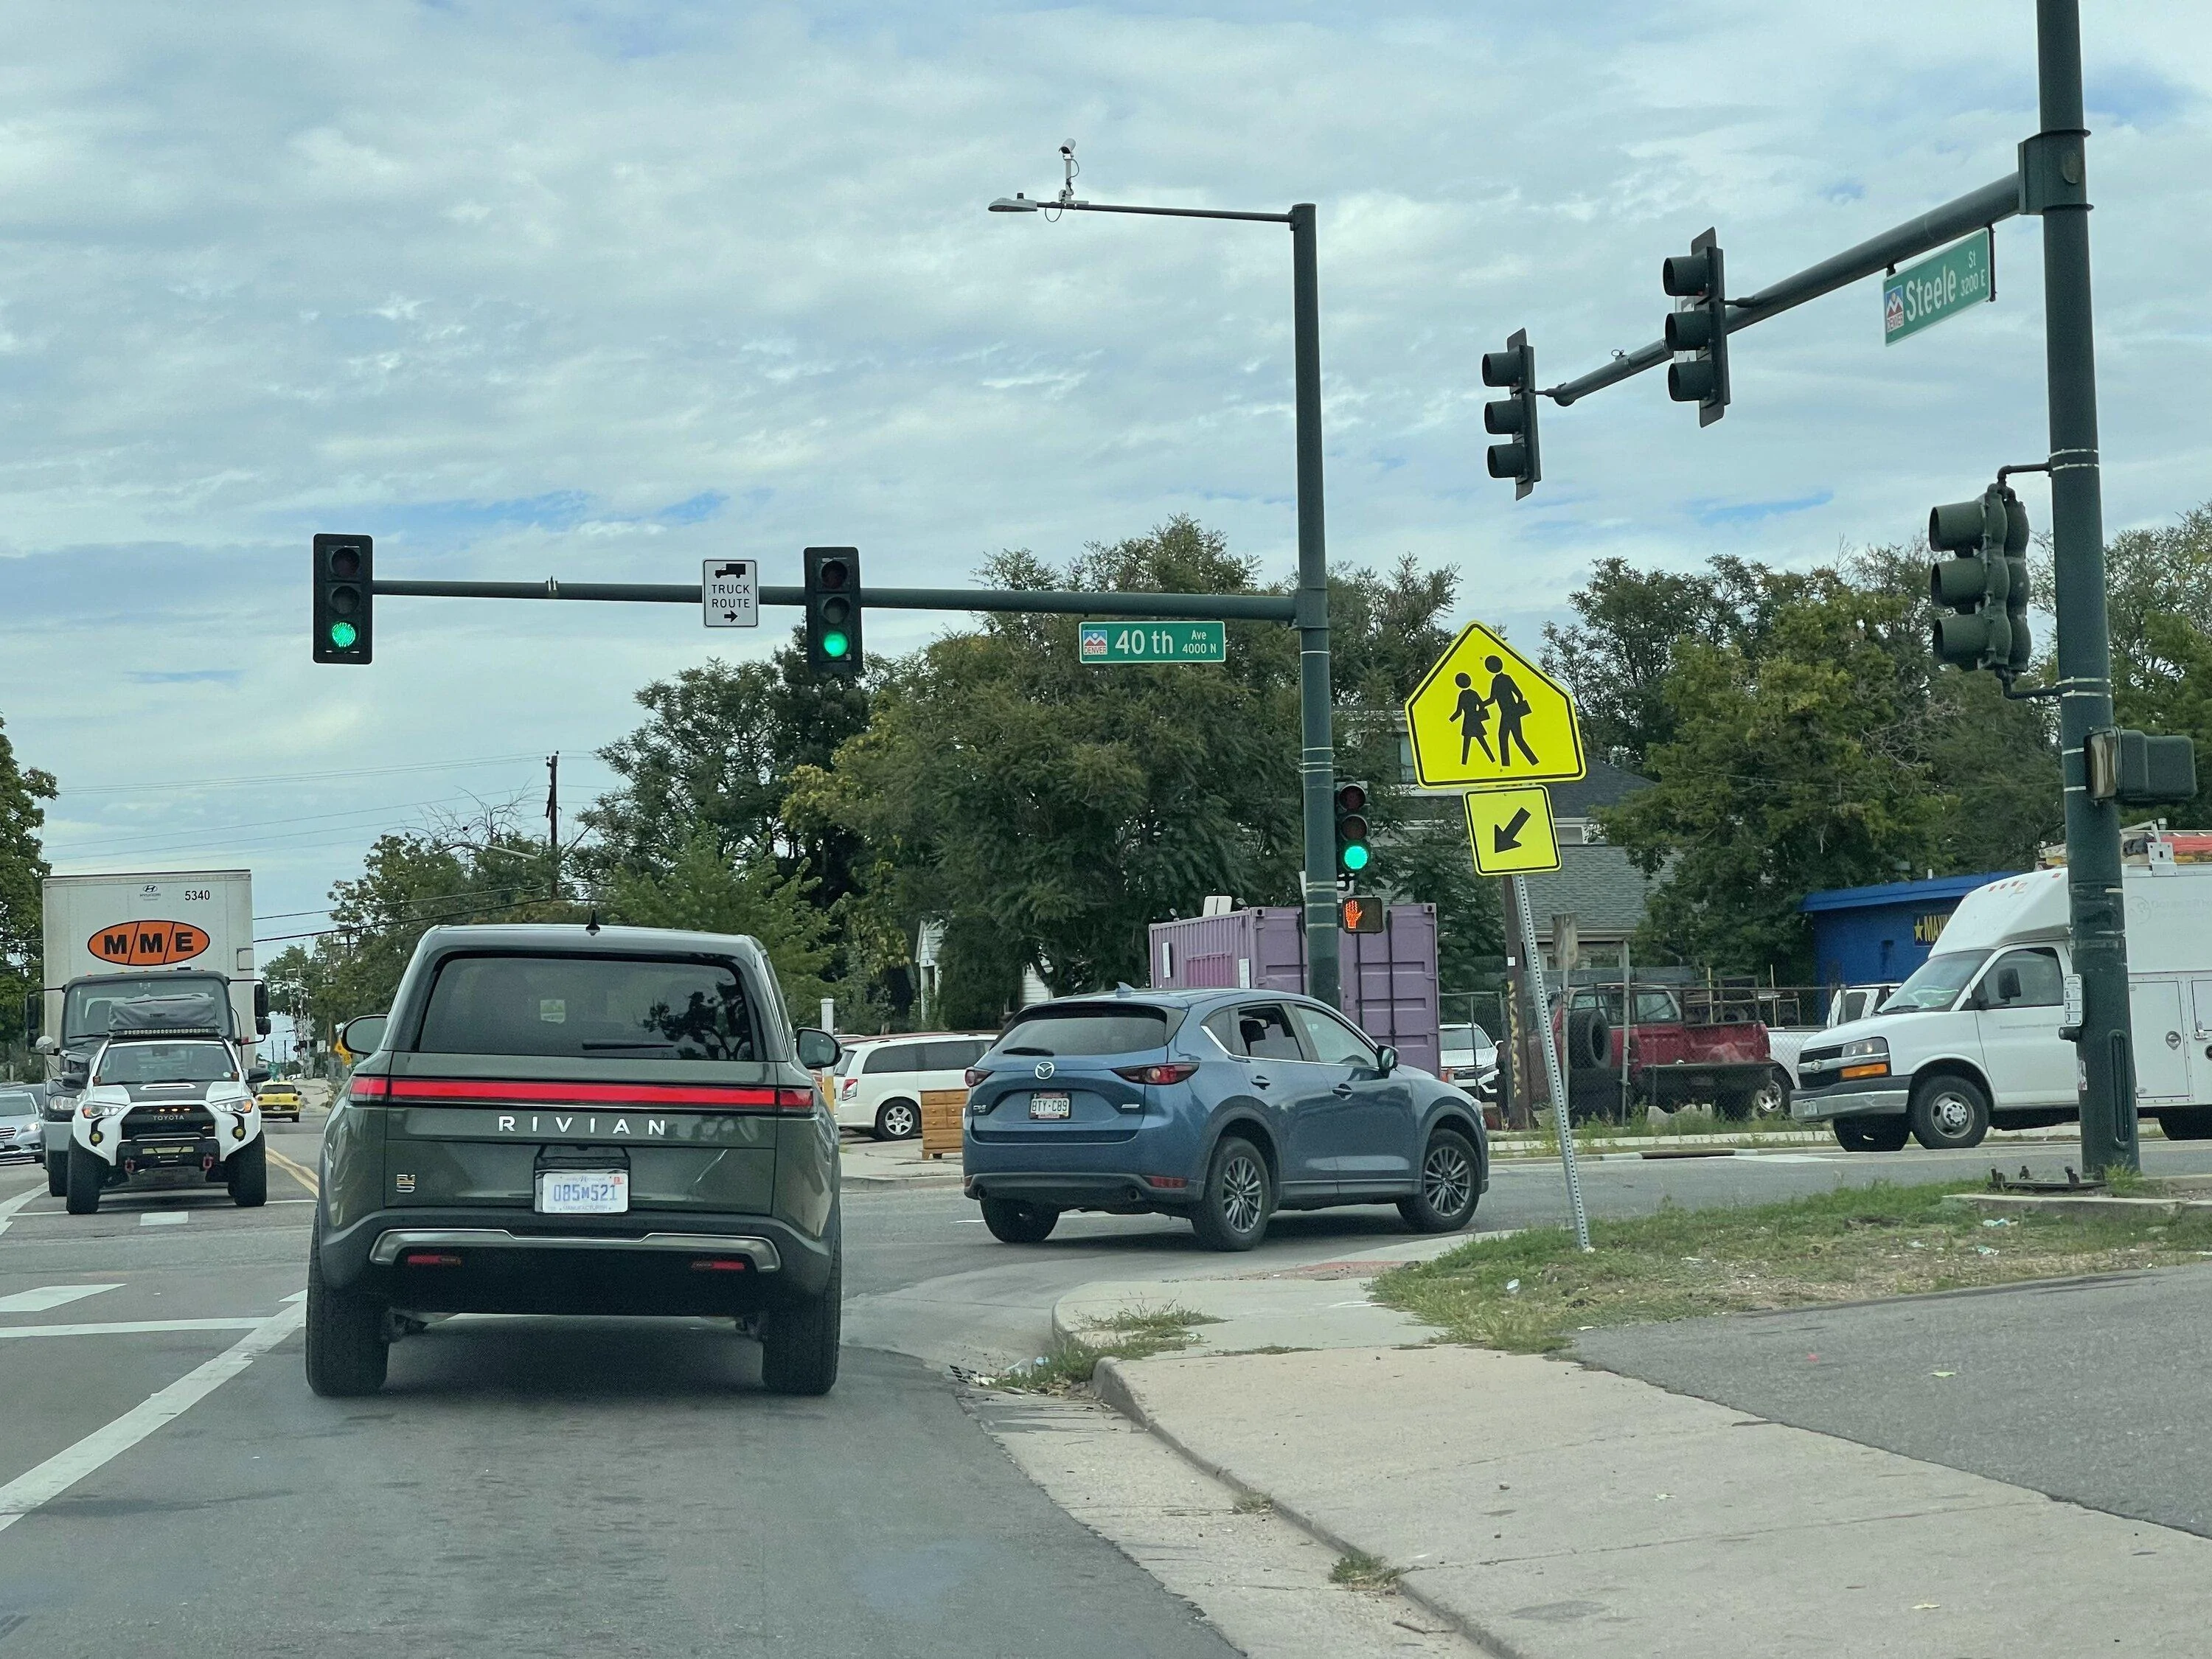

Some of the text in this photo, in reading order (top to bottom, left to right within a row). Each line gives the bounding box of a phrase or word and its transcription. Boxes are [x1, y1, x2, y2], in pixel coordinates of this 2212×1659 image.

[1968, 250, 1976, 268] St
[1961, 269, 1986, 296] 3200 E
[1906, 264, 1956, 321] Steele
[712, 585, 750, 594] TRUCK
[712, 599, 750, 608] ROUTE
[1191, 630, 1206, 640] Ave
[1115, 630, 1174, 655] 40 th
[1084, 647, 1106, 655] DENVER
[1182, 643, 1217, 654] 4000 N
[184, 890, 210, 901] 5340
[498, 1116, 666, 1135] RIVIAN
